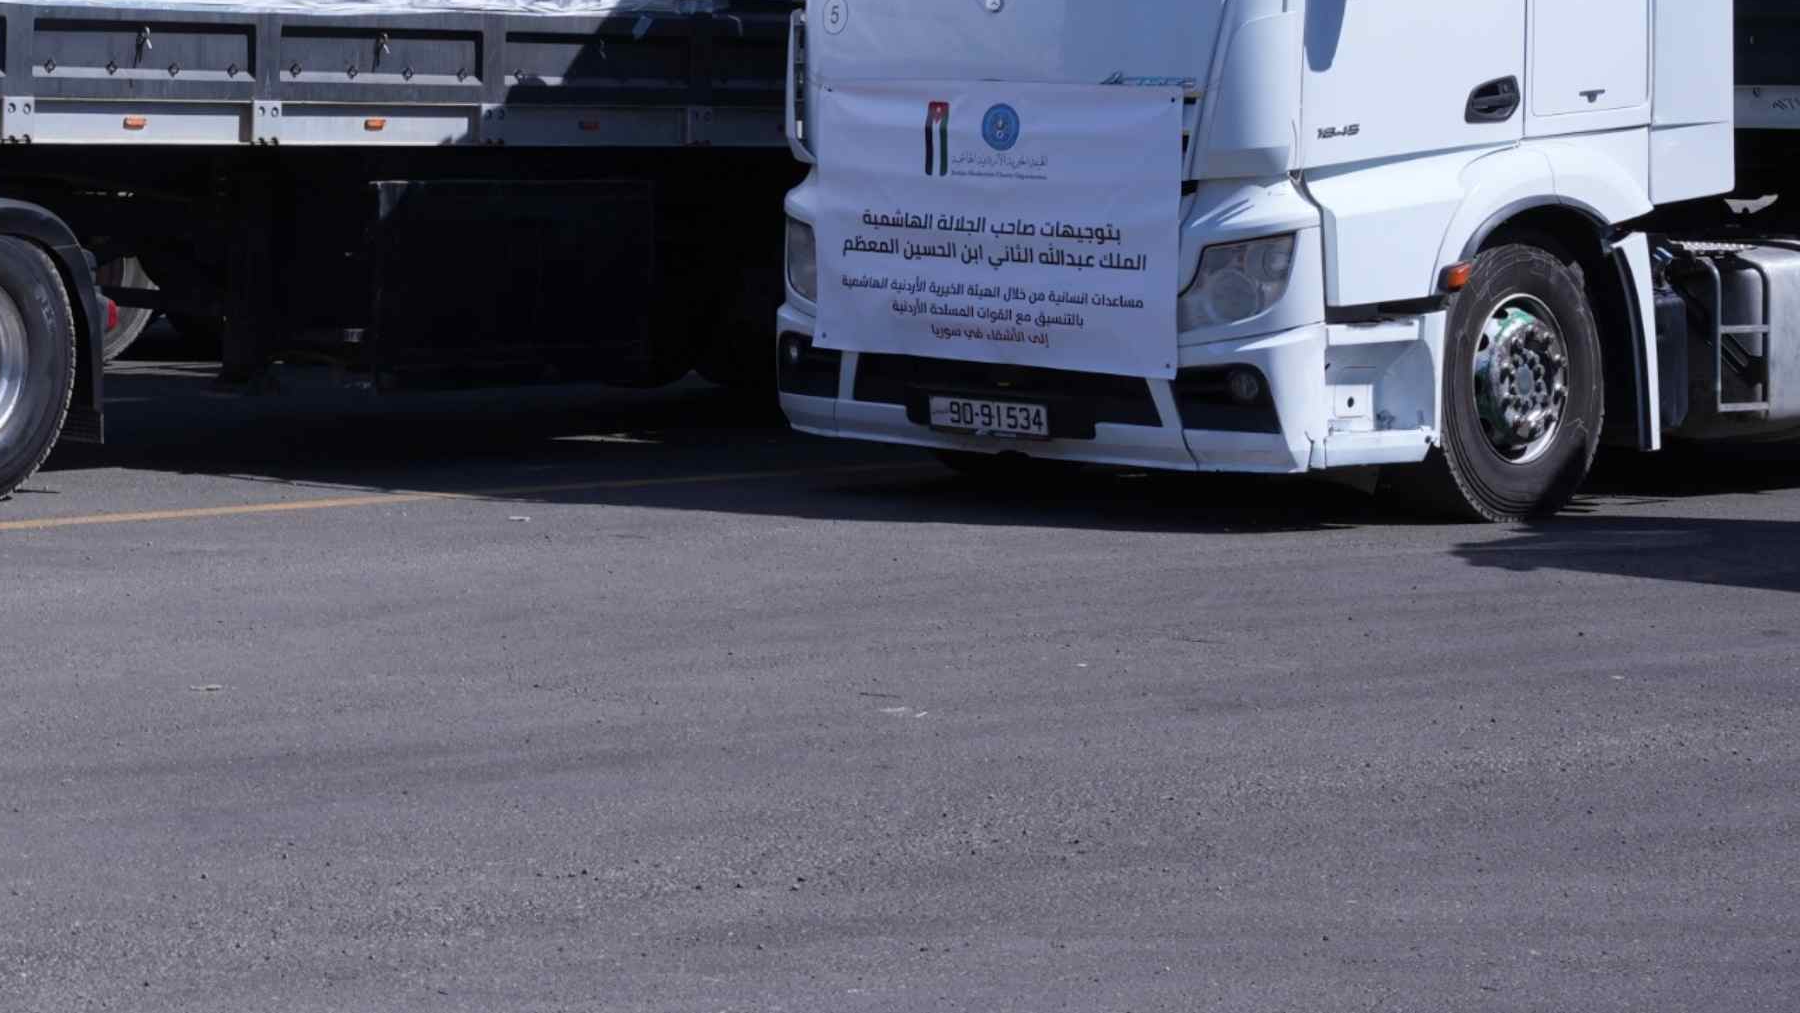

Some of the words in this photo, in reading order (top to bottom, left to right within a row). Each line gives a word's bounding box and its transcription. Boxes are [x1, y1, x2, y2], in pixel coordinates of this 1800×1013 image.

[830, 5, 840, 25] 5
[862, 209, 933, 230] الهاشمية
[936, 213, 986, 236] الجلالة
[989, 217, 1036, 239] صاحب
[1039, 220, 1122, 247] بتوجيهات
[841, 234, 900, 257] المعظم
[903, 239, 957, 262] الحسين
[960, 243, 984, 265] ابن
[987, 243, 1034, 271] الثاني
[1038, 242, 1095, 272] عبدالله
[1098, 250, 1147, 272] الملك
[841, 273, 888, 290] الهاشمية
[890, 275, 926, 295] الأردنية
[928, 281, 964, 298] الخيرية
[966, 283, 1001, 300] الهيئة
[1003, 286, 1026, 302] خلال
[1028, 291, 1045, 305] من
[1047, 289, 1089, 307] انسانية
[1091, 294, 1145, 309] مساعدات
[891, 298, 928, 317] الأردنية
[929, 302, 974, 318] المسلحة
[977, 306, 1013, 324] القوات
[1015, 312, 1032, 326] مع
[1034, 311, 1085, 328] بالتنسيق
[949, 400, 1044, 431] 90-91534
